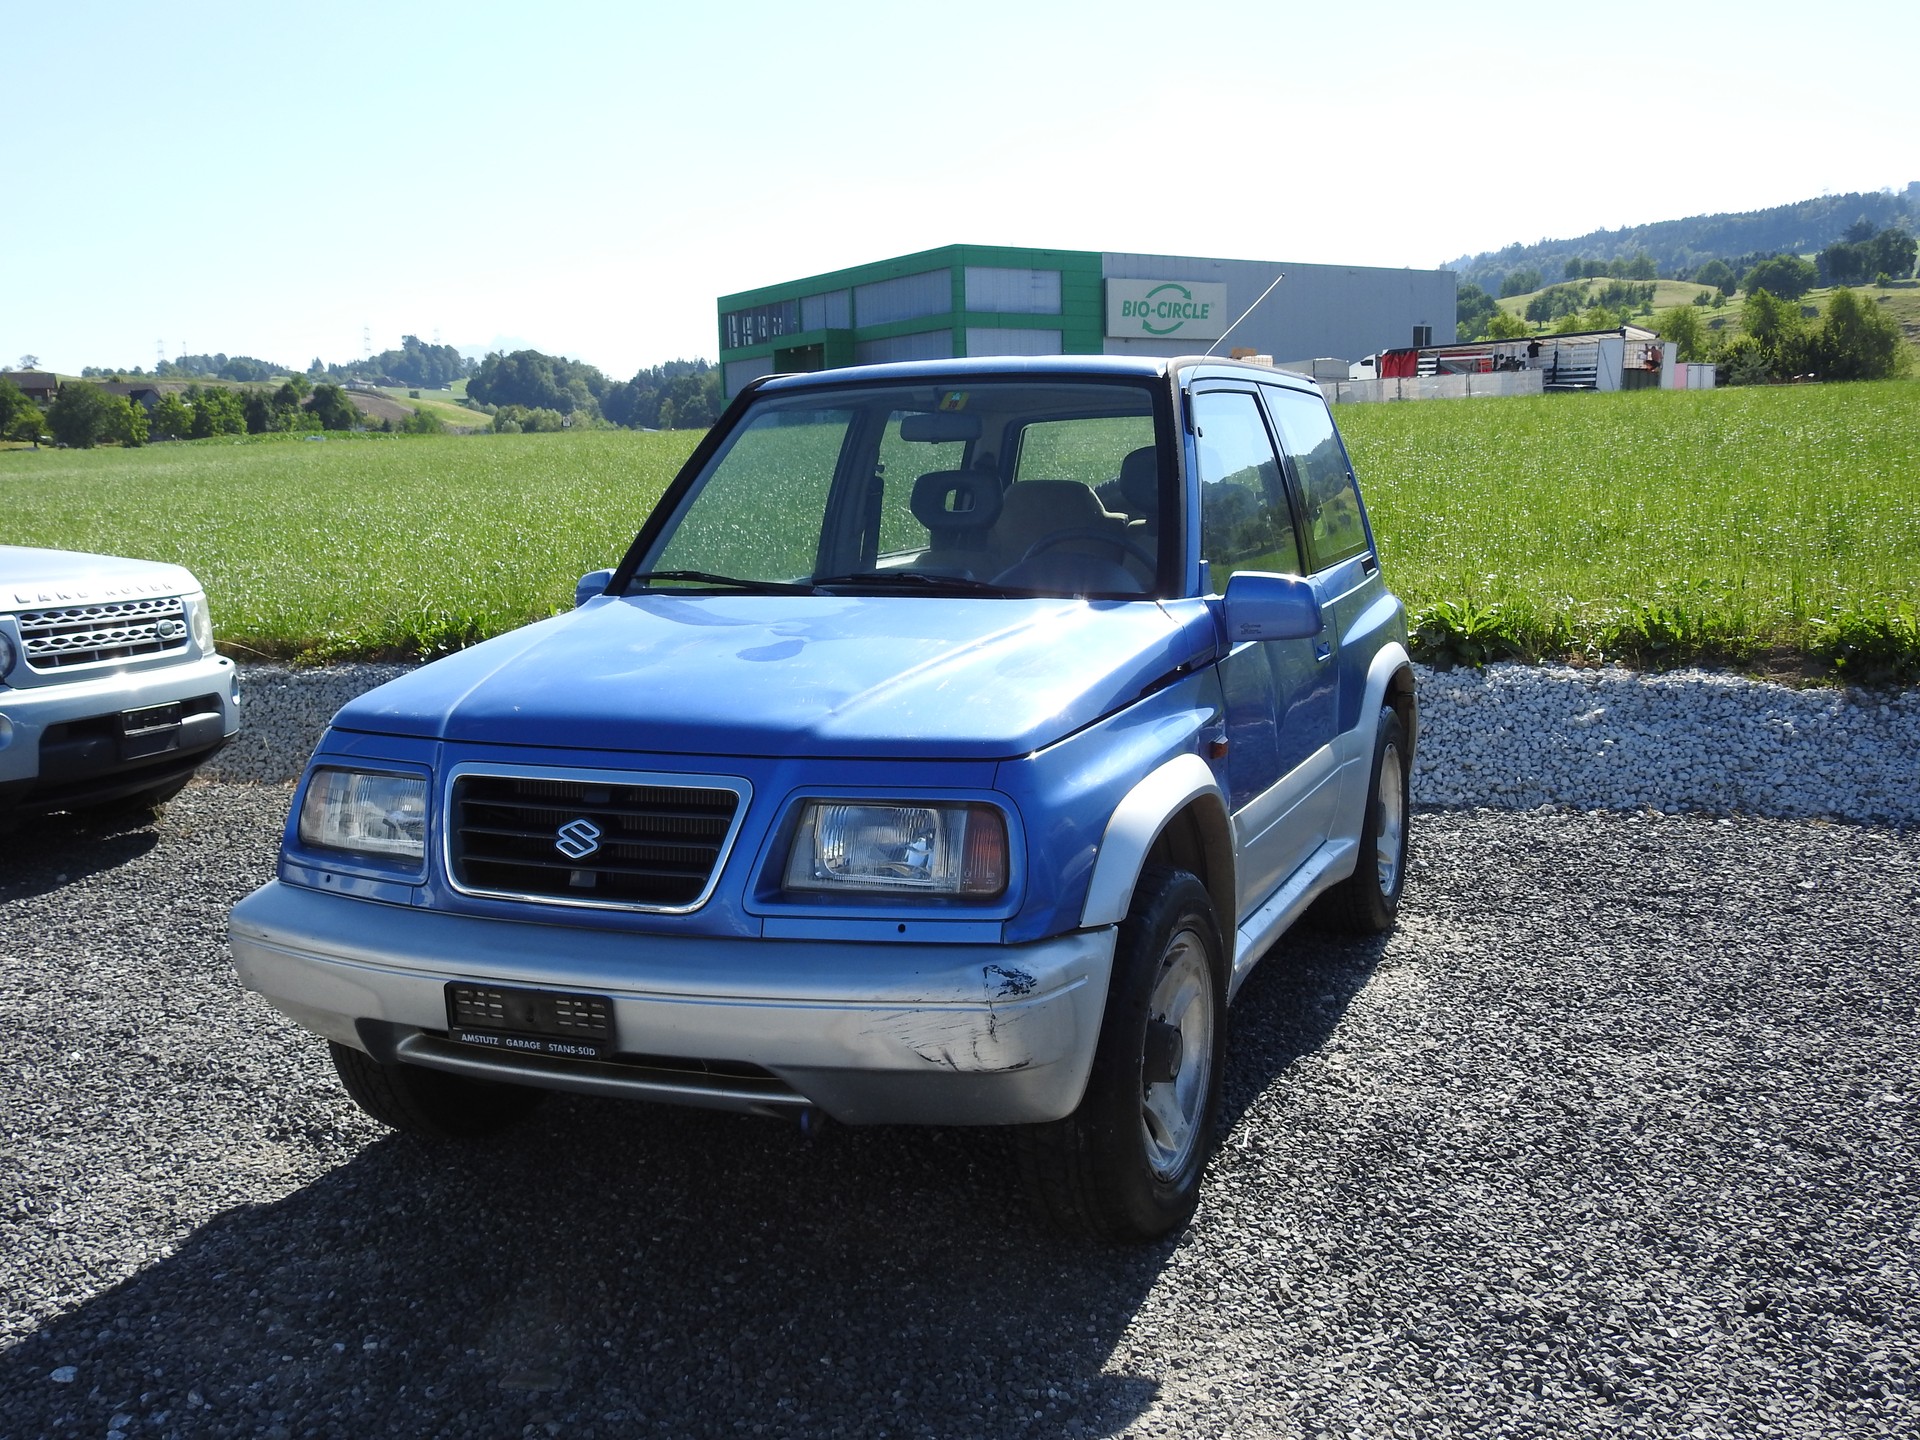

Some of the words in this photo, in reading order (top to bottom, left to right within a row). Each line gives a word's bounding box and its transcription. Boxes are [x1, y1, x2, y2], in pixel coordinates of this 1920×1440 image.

[1122, 300, 1210, 319] BIO-CIRCLE
[461, 1033, 499, 1045] AMSTUTZ
[506, 1038, 541, 1050] GARAGE
[548, 1043, 596, 1056] STANS-SÜD
